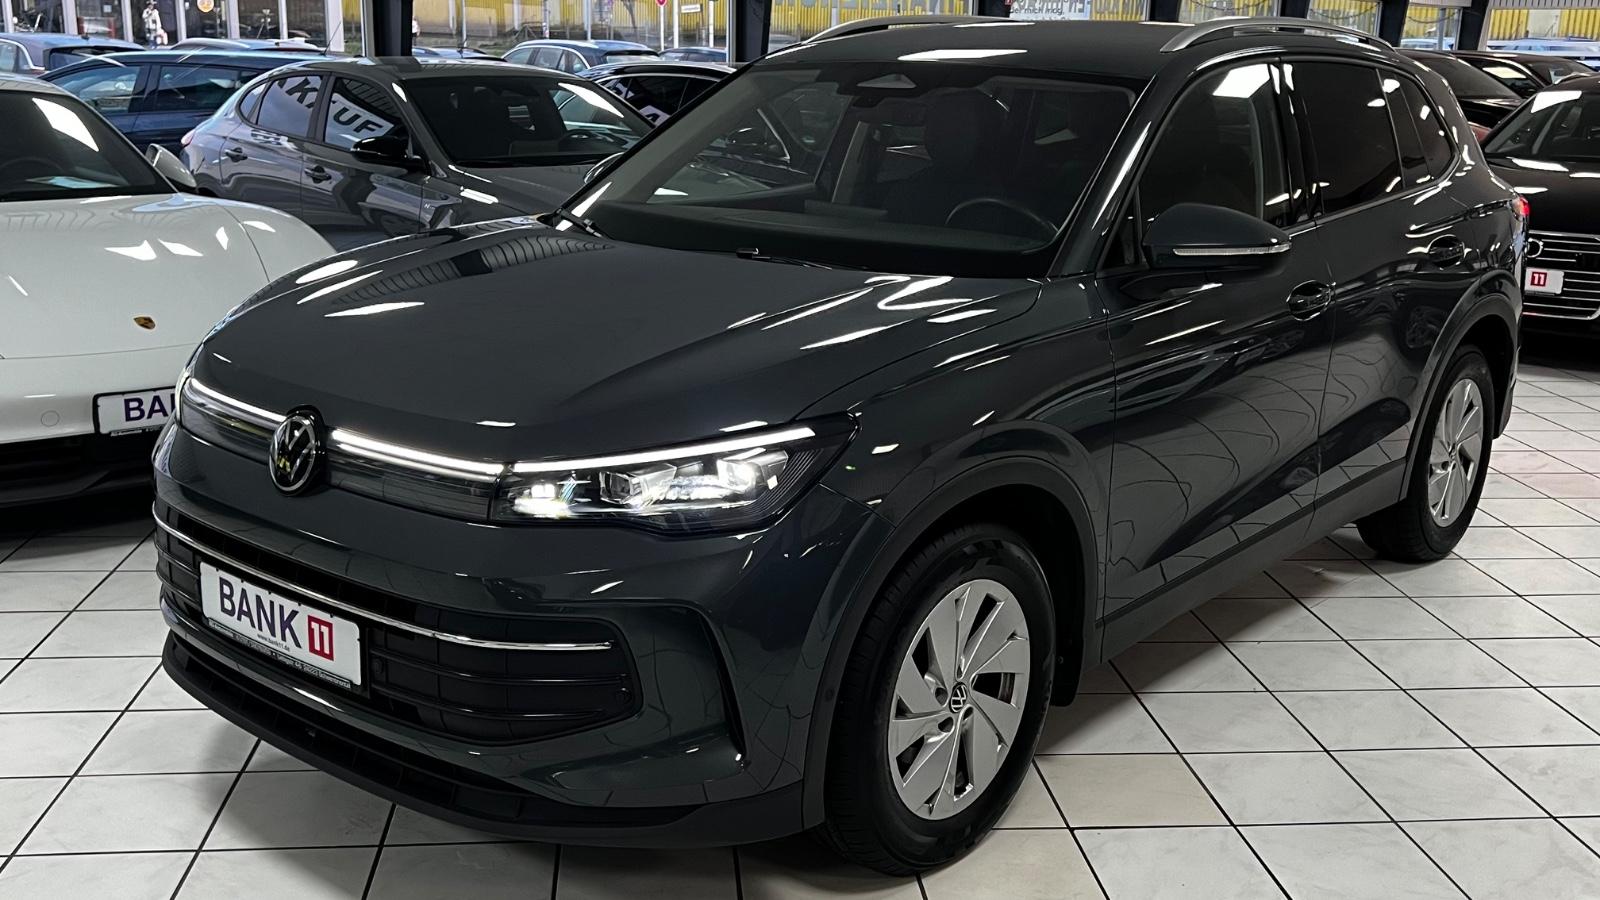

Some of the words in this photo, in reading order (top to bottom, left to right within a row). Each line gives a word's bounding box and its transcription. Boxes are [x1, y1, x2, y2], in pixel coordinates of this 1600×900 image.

[1532, 273, 1546, 286] 11
[219, 576, 302, 649] BANK
[310, 619, 332, 658] 11
